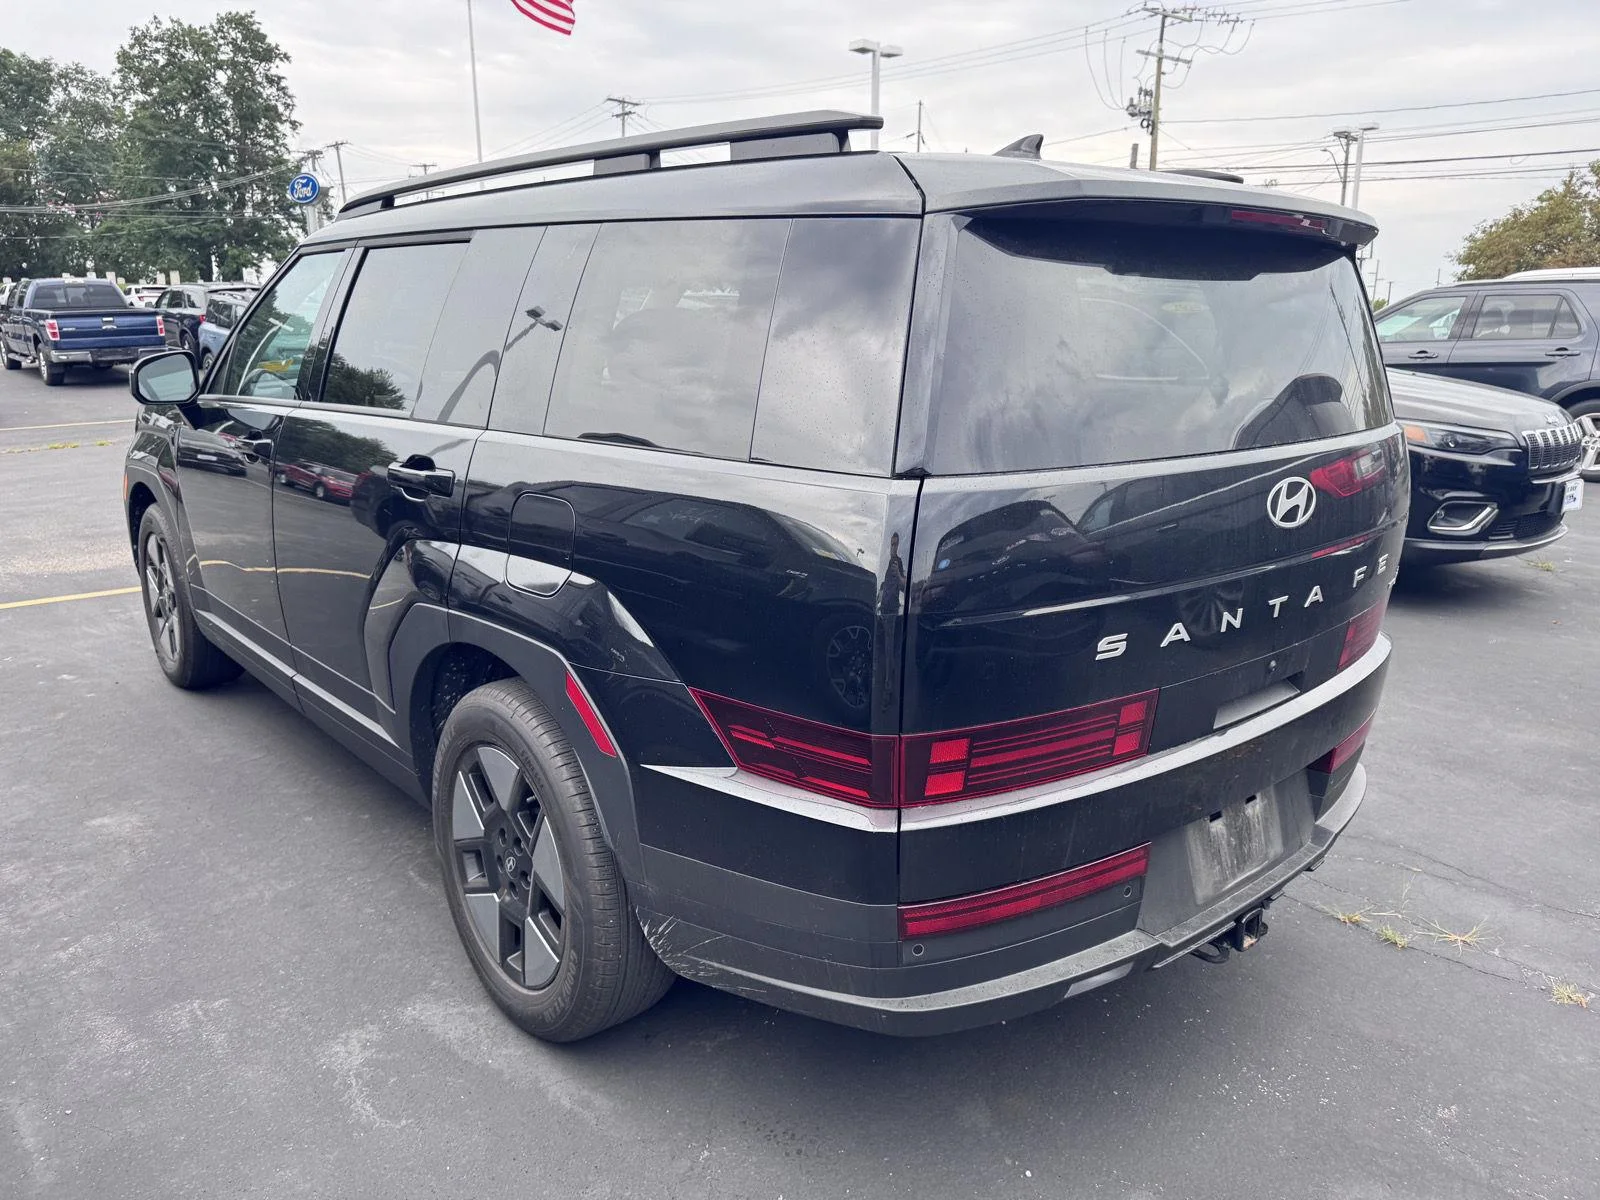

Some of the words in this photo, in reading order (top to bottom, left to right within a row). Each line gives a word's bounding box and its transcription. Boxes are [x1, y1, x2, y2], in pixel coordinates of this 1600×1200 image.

[293, 178, 313, 198] Ford
[1095, 585, 1324, 661] SANTA
[1352, 553, 1389, 589] FE
